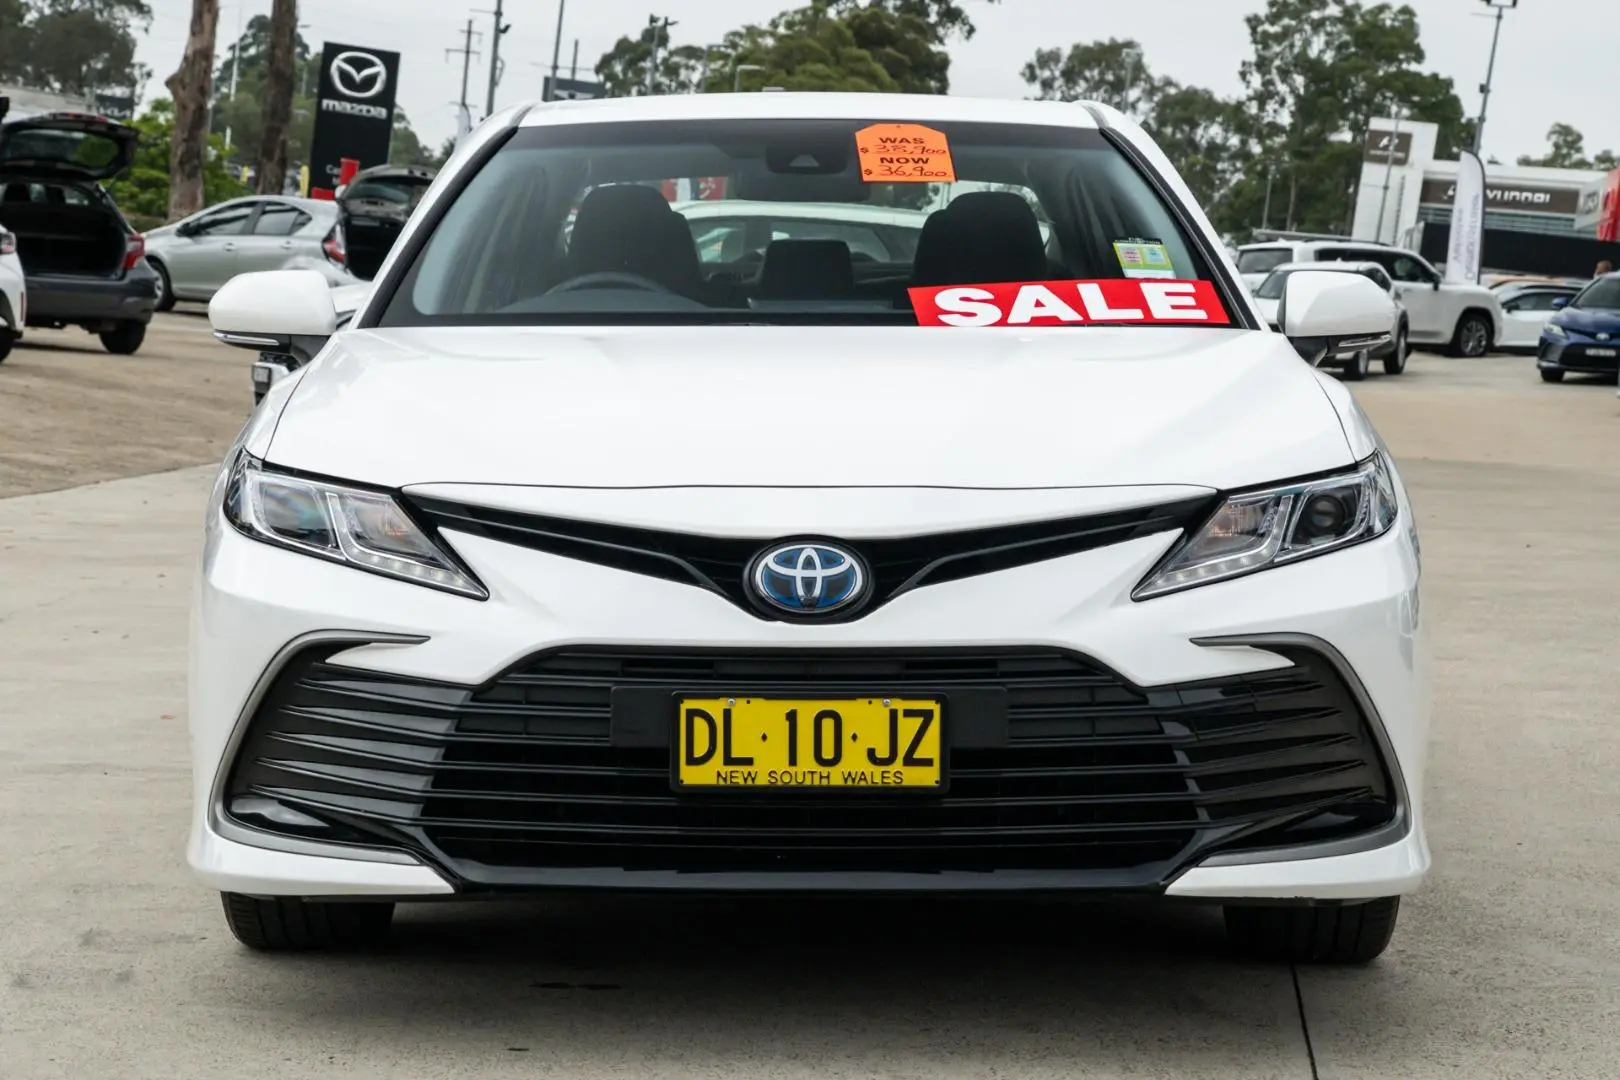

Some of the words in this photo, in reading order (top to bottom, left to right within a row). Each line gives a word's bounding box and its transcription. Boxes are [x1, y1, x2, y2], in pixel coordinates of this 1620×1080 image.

[322, 99, 387, 119] mazda
[879, 165, 947, 176] 36,900
[934, 282, 1208, 327] SALE
[716, 770, 758, 785] NEW
[767, 770, 831, 785] SOUTH
[842, 770, 904, 785] WALES
